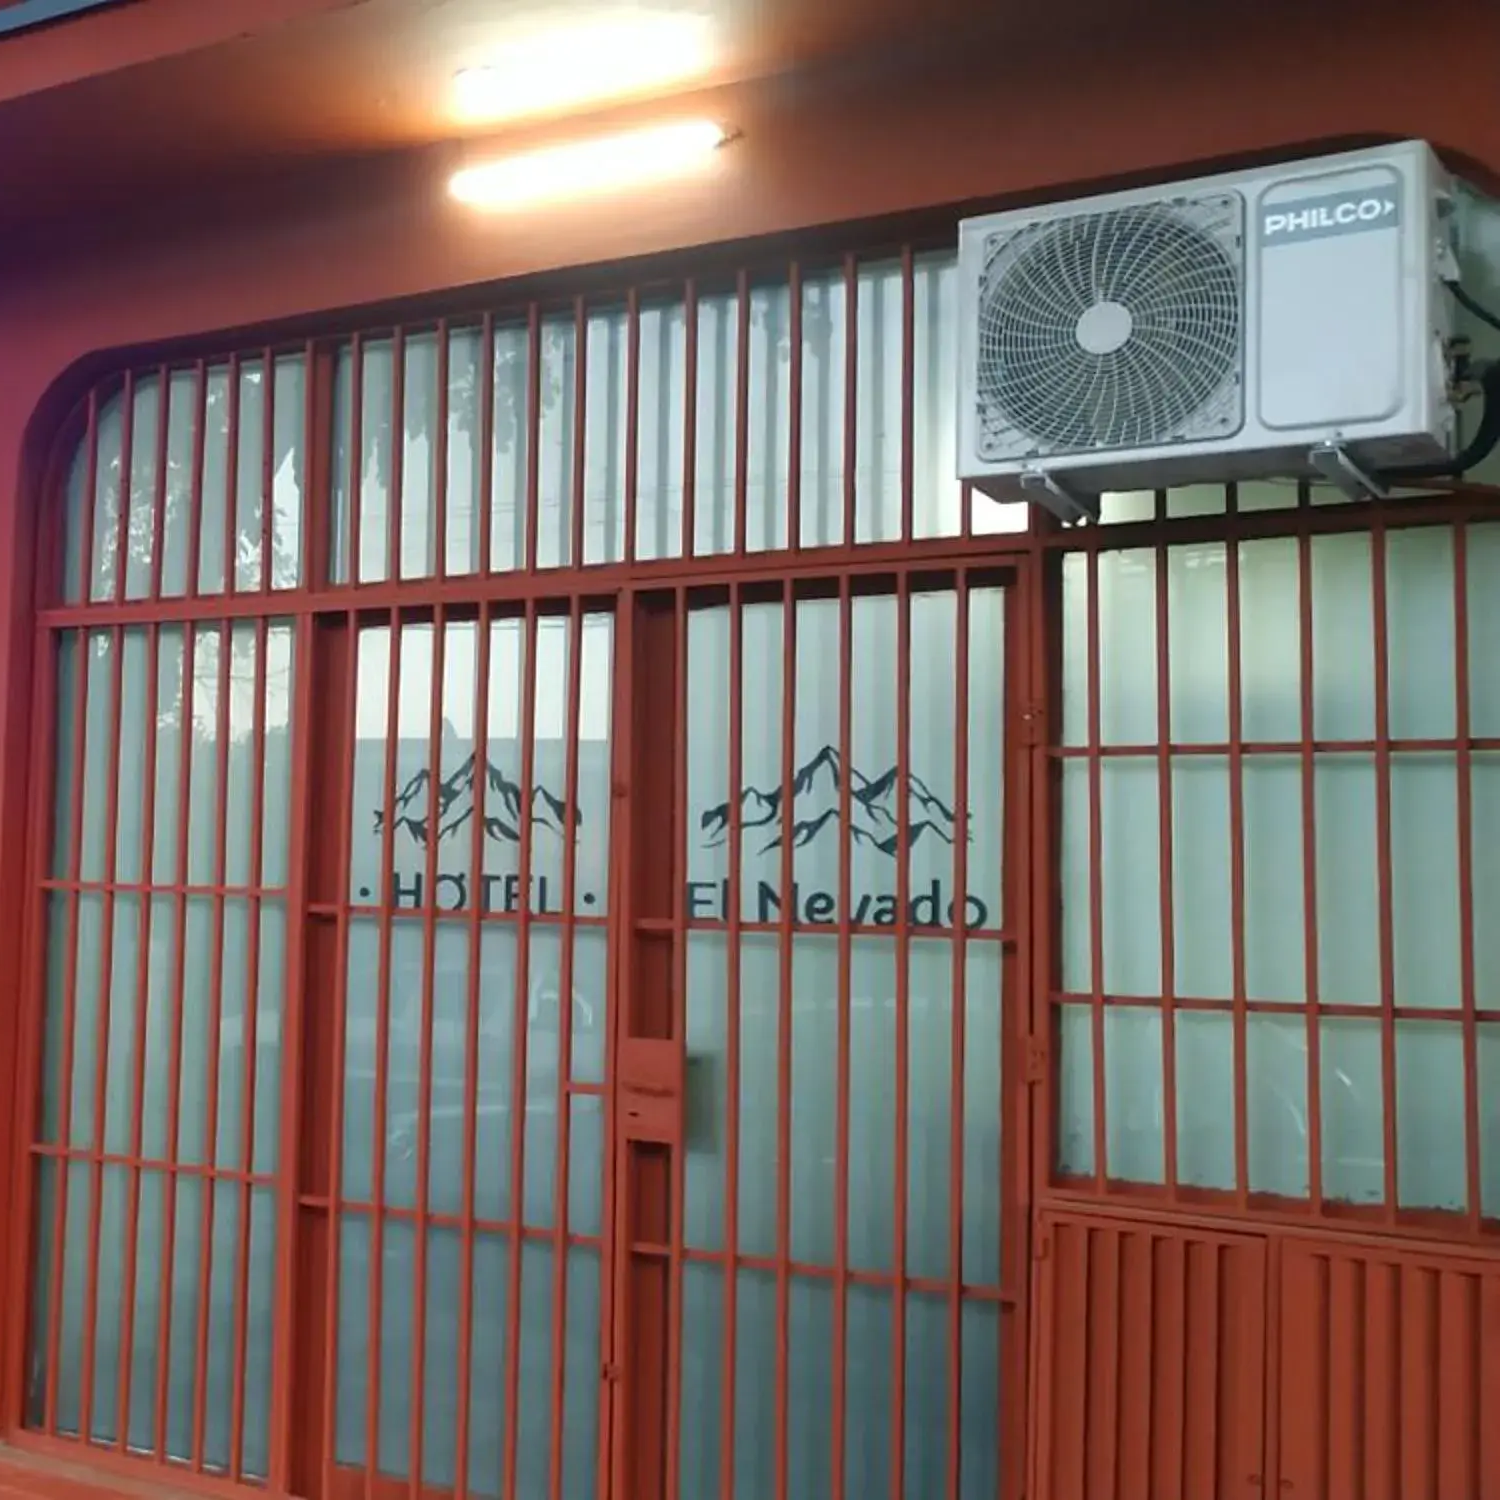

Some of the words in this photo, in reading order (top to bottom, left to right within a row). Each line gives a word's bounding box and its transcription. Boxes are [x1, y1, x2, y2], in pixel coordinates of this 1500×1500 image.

[1264, 199, 1382, 235] PHILCO
[393, 872, 566, 914] HOTEL
[686, 879, 730, 921] El
[757, 879, 989, 931] Nevado
